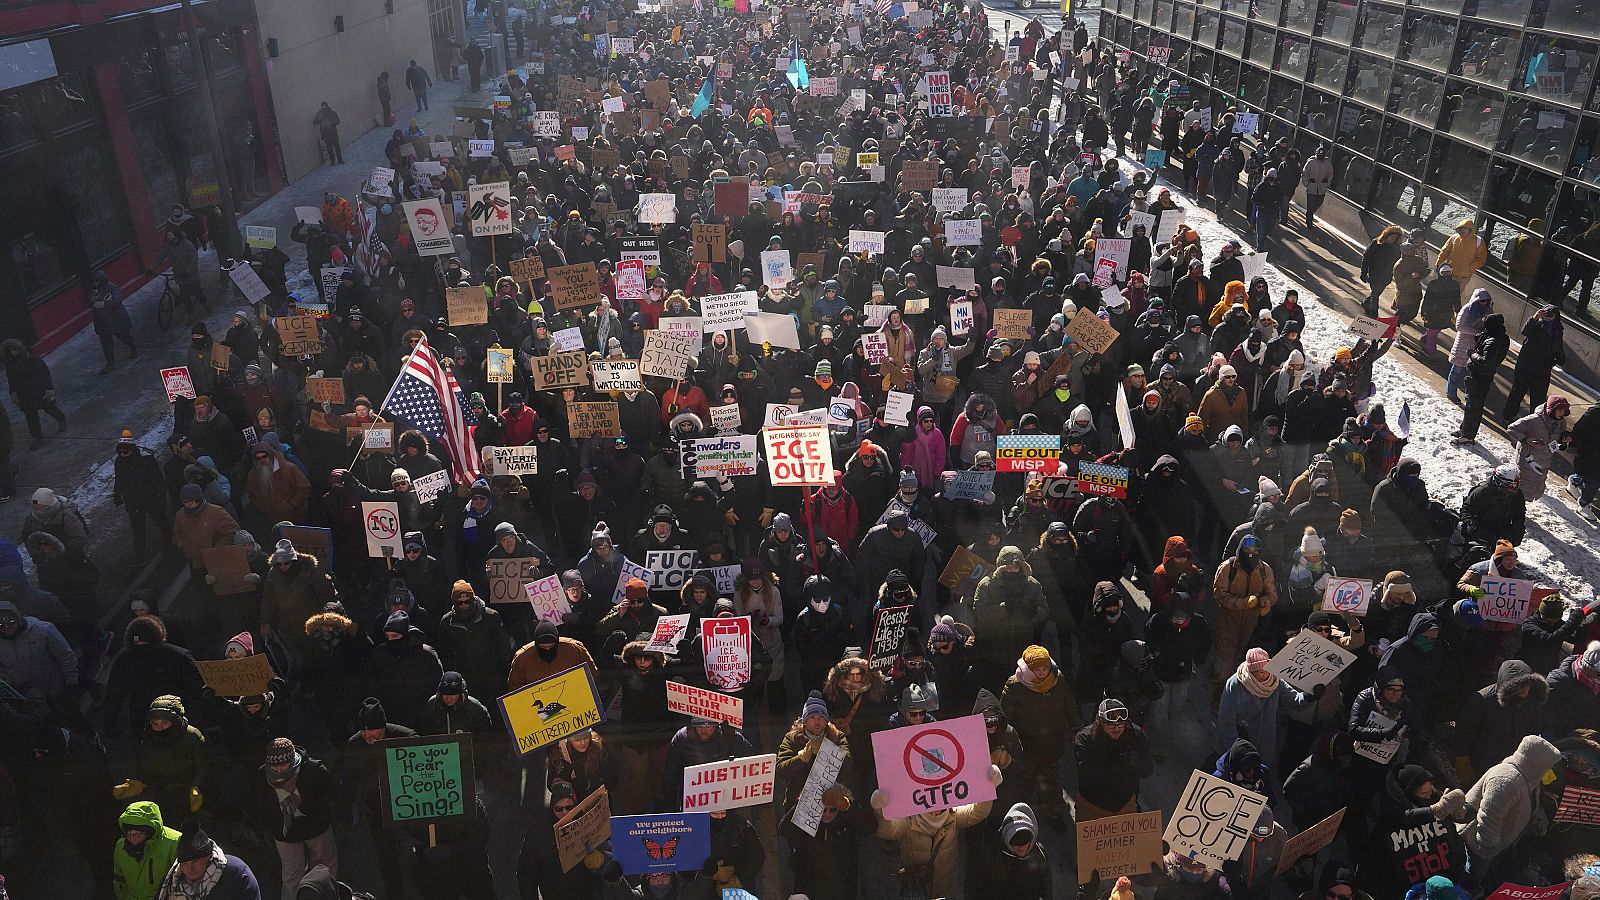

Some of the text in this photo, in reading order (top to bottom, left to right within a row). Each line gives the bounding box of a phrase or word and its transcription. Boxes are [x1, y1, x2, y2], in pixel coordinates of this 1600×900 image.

[928, 74, 948, 87] NO
[929, 86, 949, 94] KINGS
[930, 93, 950, 105] NO
[931, 104, 951, 115] ICE
[474, 224, 510, 233] ON MN
[697, 225, 719, 233] ICE
[696, 235, 721, 243] OUT
[512, 257, 541, 269] STOP
[554, 265, 589, 277] What Would
[564, 274, 584, 284] YOU
[556, 284, 573, 292] Have
[705, 293, 742, 303] OPERATION
[706, 301, 728, 310] METRO
[719, 308, 744, 317] SAFETY
[956, 307, 968, 318] MN
[998, 312, 1029, 320] RELEASE
[1080, 311, 1096, 325] MORE
[281, 317, 311, 331] ICE
[647, 338, 691, 355] POLICE
[1071, 327, 1102, 352] THUGS
[537, 356, 583, 372] HANDS
[592, 362, 636, 371] THE WORLD
[644, 350, 688, 370] STATE
[642, 363, 672, 376] LOOKS
[595, 381, 642, 390] WATCHING
[569, 403, 617, 413] THE SMALLEST
[576, 412, 607, 421] MEN WHO
[573, 420, 613, 430] EVER LIVED
[769, 433, 807, 441] NEIGHBORS
[494, 449, 513, 457] SAY
[771, 439, 821, 461] ICE
[999, 448, 1060, 459] ICE OUT
[506, 463, 536, 471] NAME
[774, 462, 826, 481] OUT!
[1012, 459, 1045, 470] MSP
[415, 473, 445, 487] THIS IS
[1079, 472, 1128, 488] ICE OUT
[1043, 479, 1078, 498] ICE
[1089, 484, 1117, 494] MSP
[371, 515, 395, 532] ICE
[492, 561, 531, 578] ICE
[623, 561, 649, 582] ICE
[528, 576, 559, 597] ICE
[1484, 580, 1517, 597] ICE
[532, 589, 560, 606] OUT
[1337, 589, 1361, 606] ICE
[1496, 596, 1528, 611] OUT
[542, 598, 560, 612] OF
[542, 607, 568, 624] MN
[879, 609, 910, 625] Resist
[876, 640, 898, 654] 1938
[717, 655, 738, 664] OUT OF
[1289, 651, 1334, 677] ICE OUT
[708, 662, 747, 672] MINNEAPOLIS
[1280, 665, 1313, 681] MN
[667, 682, 740, 707] SUPPORT
[688, 696, 720, 710] OUR
[667, 700, 743, 727] NEIGHBORS
[543, 709, 601, 742] TREAD ON ME
[395, 747, 449, 763] Do you
[816, 750, 829, 765] TO
[403, 758, 443, 774] Hear
[823, 750, 845, 785] FREE
[419, 770, 434, 780] the
[691, 761, 772, 786] JUSTICE
[400, 774, 456, 799] People
[685, 781, 773, 809] NOT LIES
[912, 781, 969, 809] GTFO
[395, 790, 460, 819] Sing?
[1185, 777, 1263, 835] ICE
[629, 826, 693, 836] our neighbors
[655, 820, 685, 829] protect
[1082, 818, 1157, 839] SHAME ON YOU
[1176, 815, 1247, 853] OUT
[1390, 820, 1448, 853] MAKE
[1096, 836, 1135, 851] EMMER
[1173, 834, 1194, 850] for
[1417, 840, 1430, 853] IT
[1096, 850, 1130, 864] NOEM
[1403, 841, 1451, 883] STOP
[1499, 887, 1564, 900] ABOLISH
